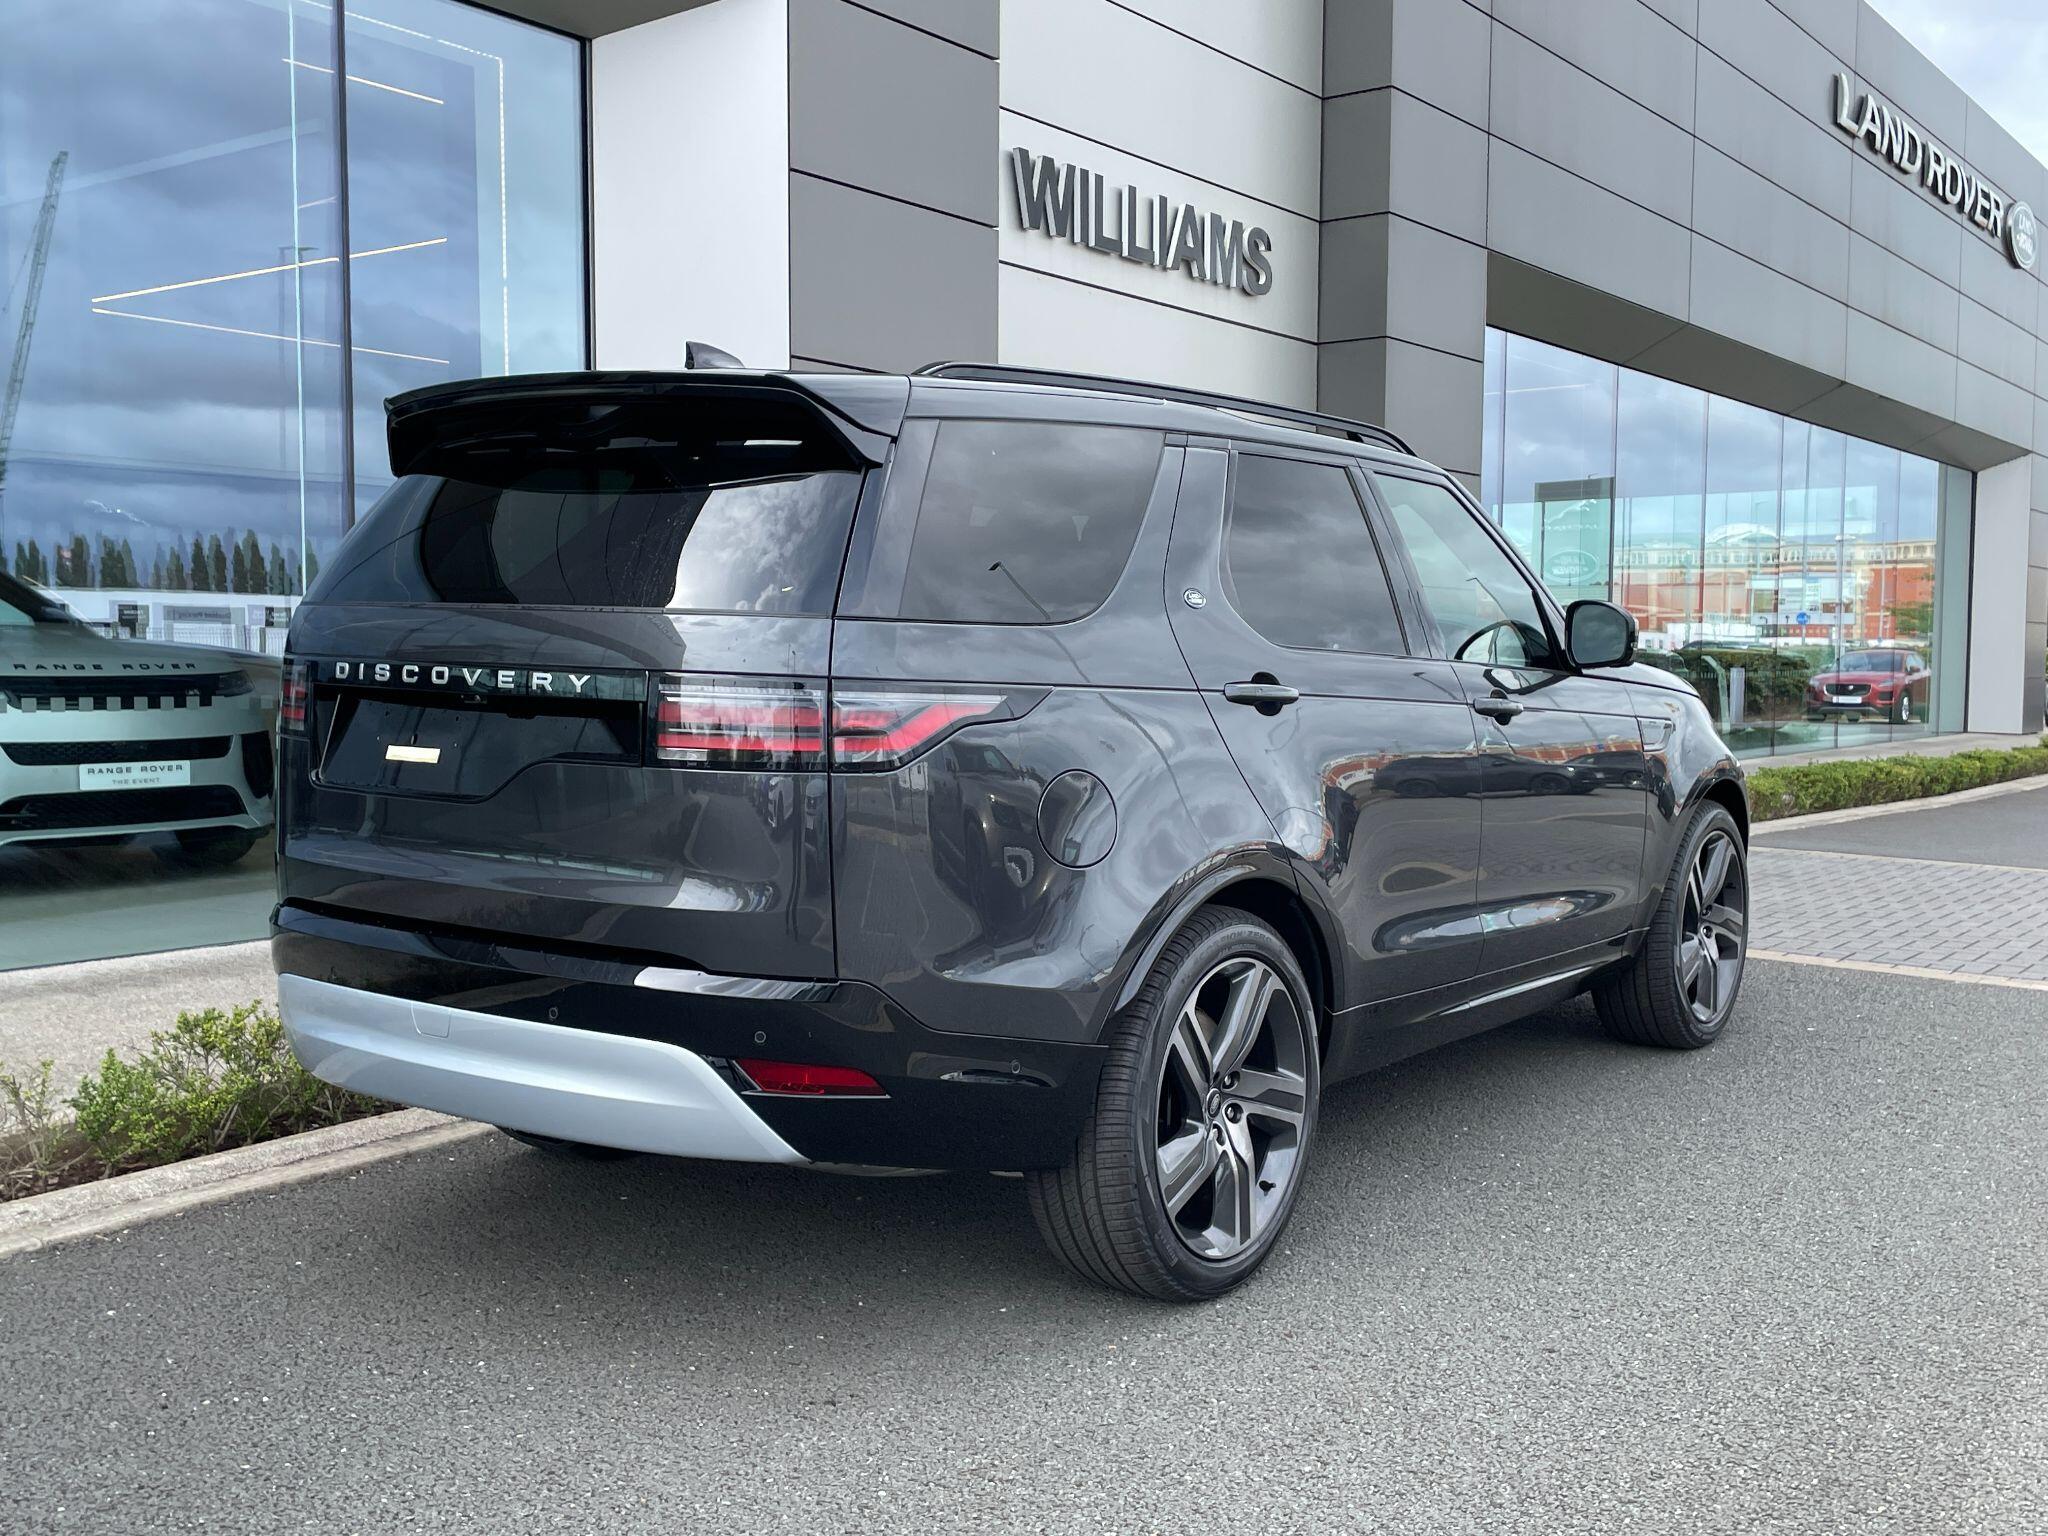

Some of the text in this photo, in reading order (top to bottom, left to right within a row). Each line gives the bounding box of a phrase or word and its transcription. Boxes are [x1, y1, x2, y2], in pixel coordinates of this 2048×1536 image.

[1834, 73, 1923, 174] LAND
[1924, 140, 2004, 238] ROVER
[1013, 147, 1273, 296] WILLIAMS
[335, 662, 591, 693] DISCOVERY
[87, 764, 183, 775] RANGE ROVER
[132, 777, 161, 785] EVENT
